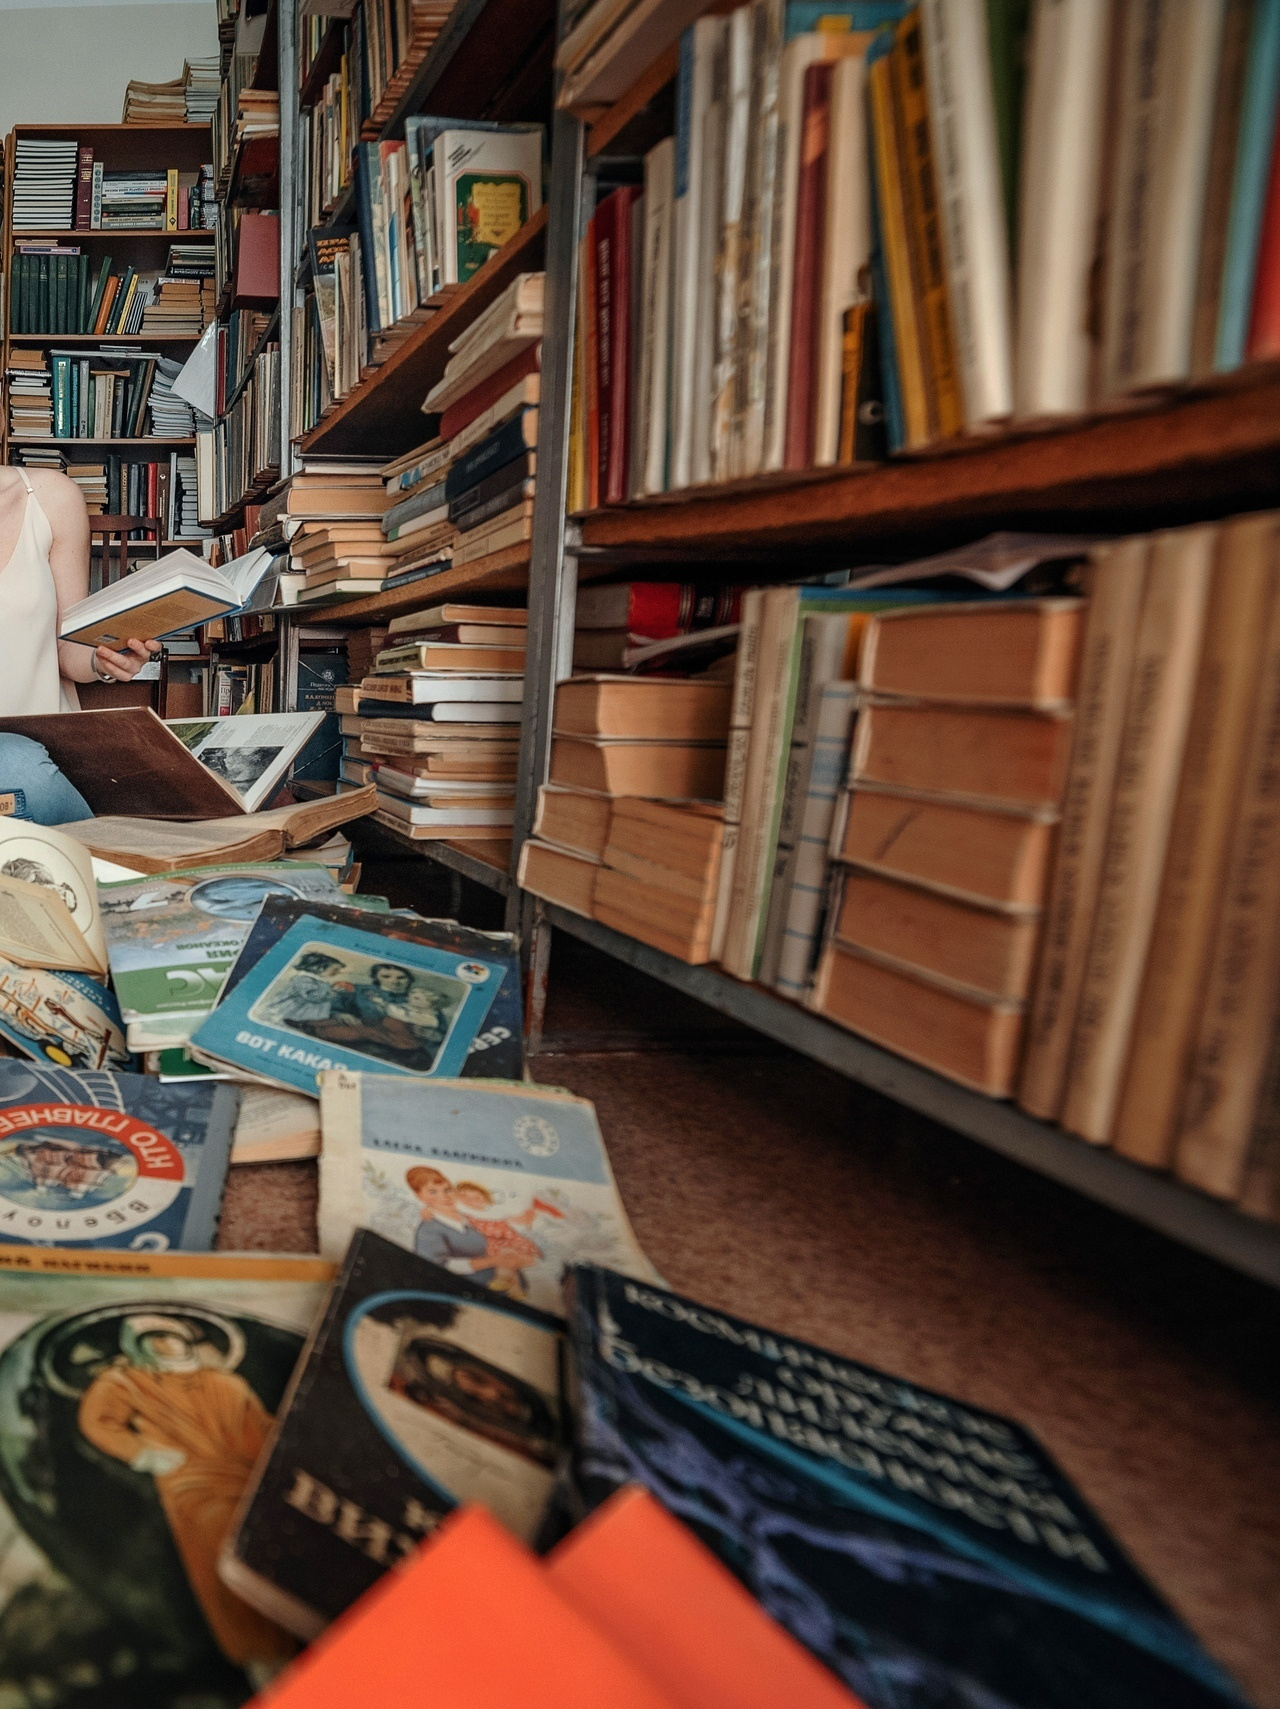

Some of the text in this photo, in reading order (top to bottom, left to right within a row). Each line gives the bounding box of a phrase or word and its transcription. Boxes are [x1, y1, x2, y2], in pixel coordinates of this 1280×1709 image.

[130, 892, 168, 911] 7
[176, 940, 239, 951] ОКЕАНОВ
[234, 1030, 277, 1053] ВОТ
[127, 1130, 176, 1170] КТО
